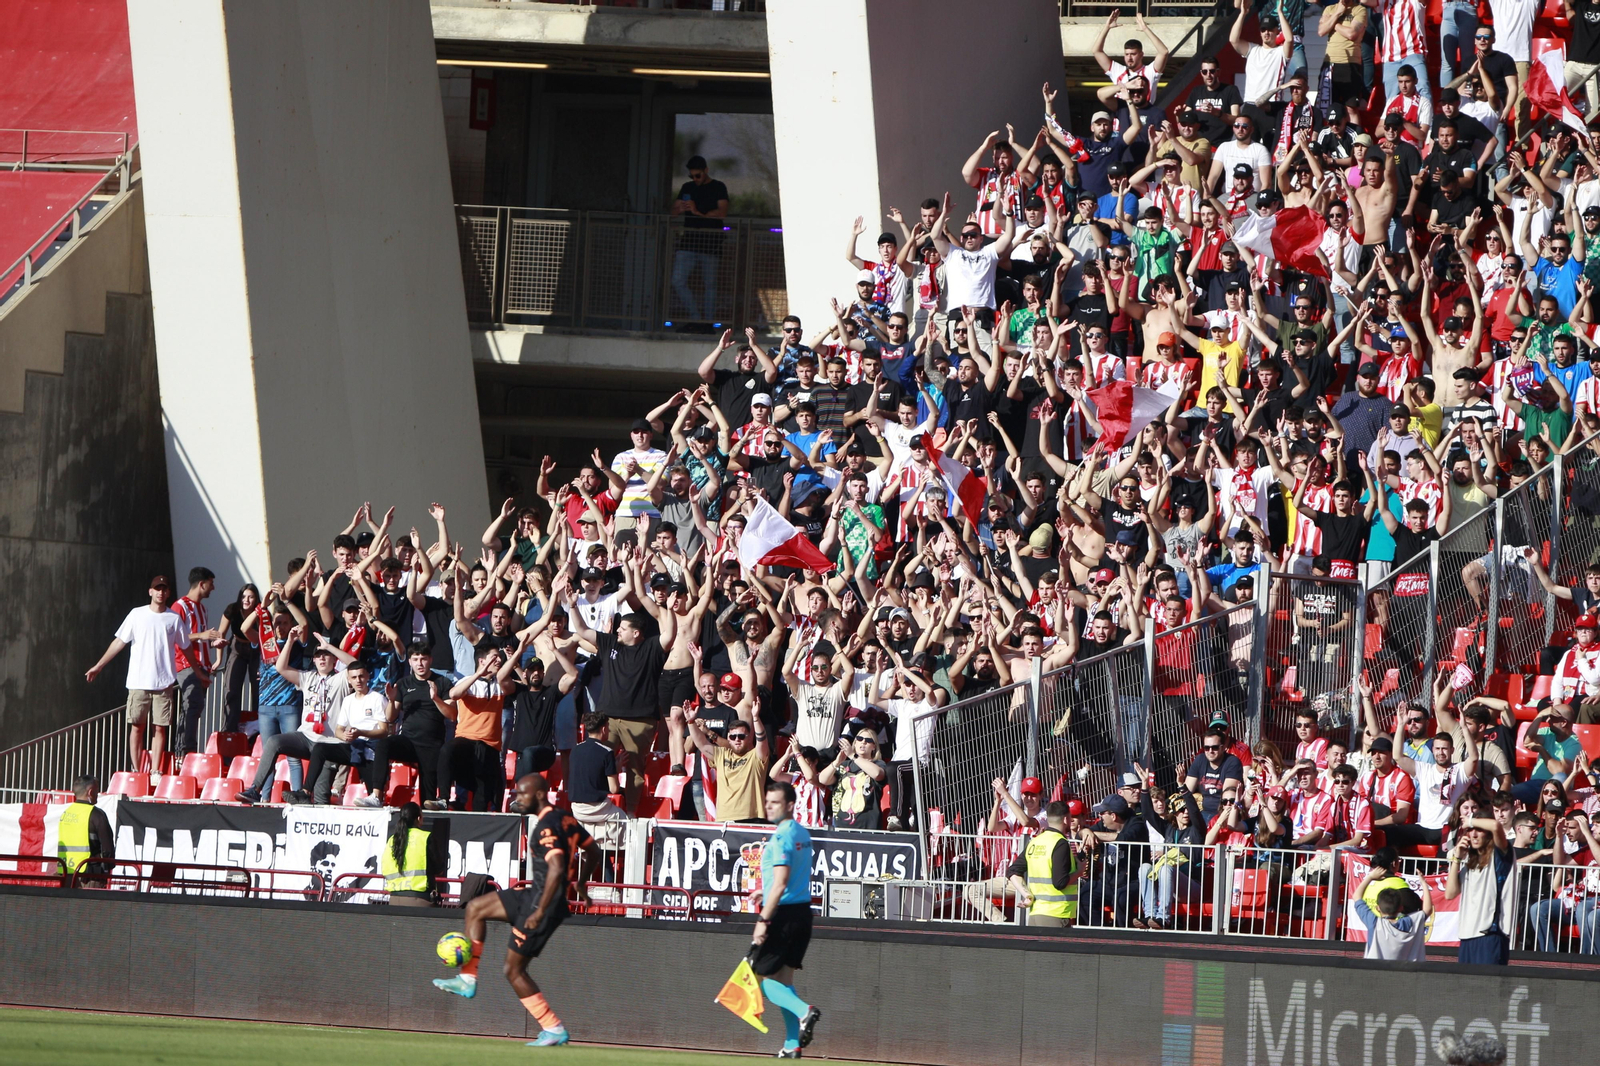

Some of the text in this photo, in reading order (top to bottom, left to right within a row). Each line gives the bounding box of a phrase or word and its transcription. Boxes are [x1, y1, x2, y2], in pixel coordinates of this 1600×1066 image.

[294, 821, 379, 838] ETERNO RAÚL
[112, 825, 287, 898] ALMERÍ
[657, 836, 731, 892] APC
[811, 848, 907, 881] ASUALS
